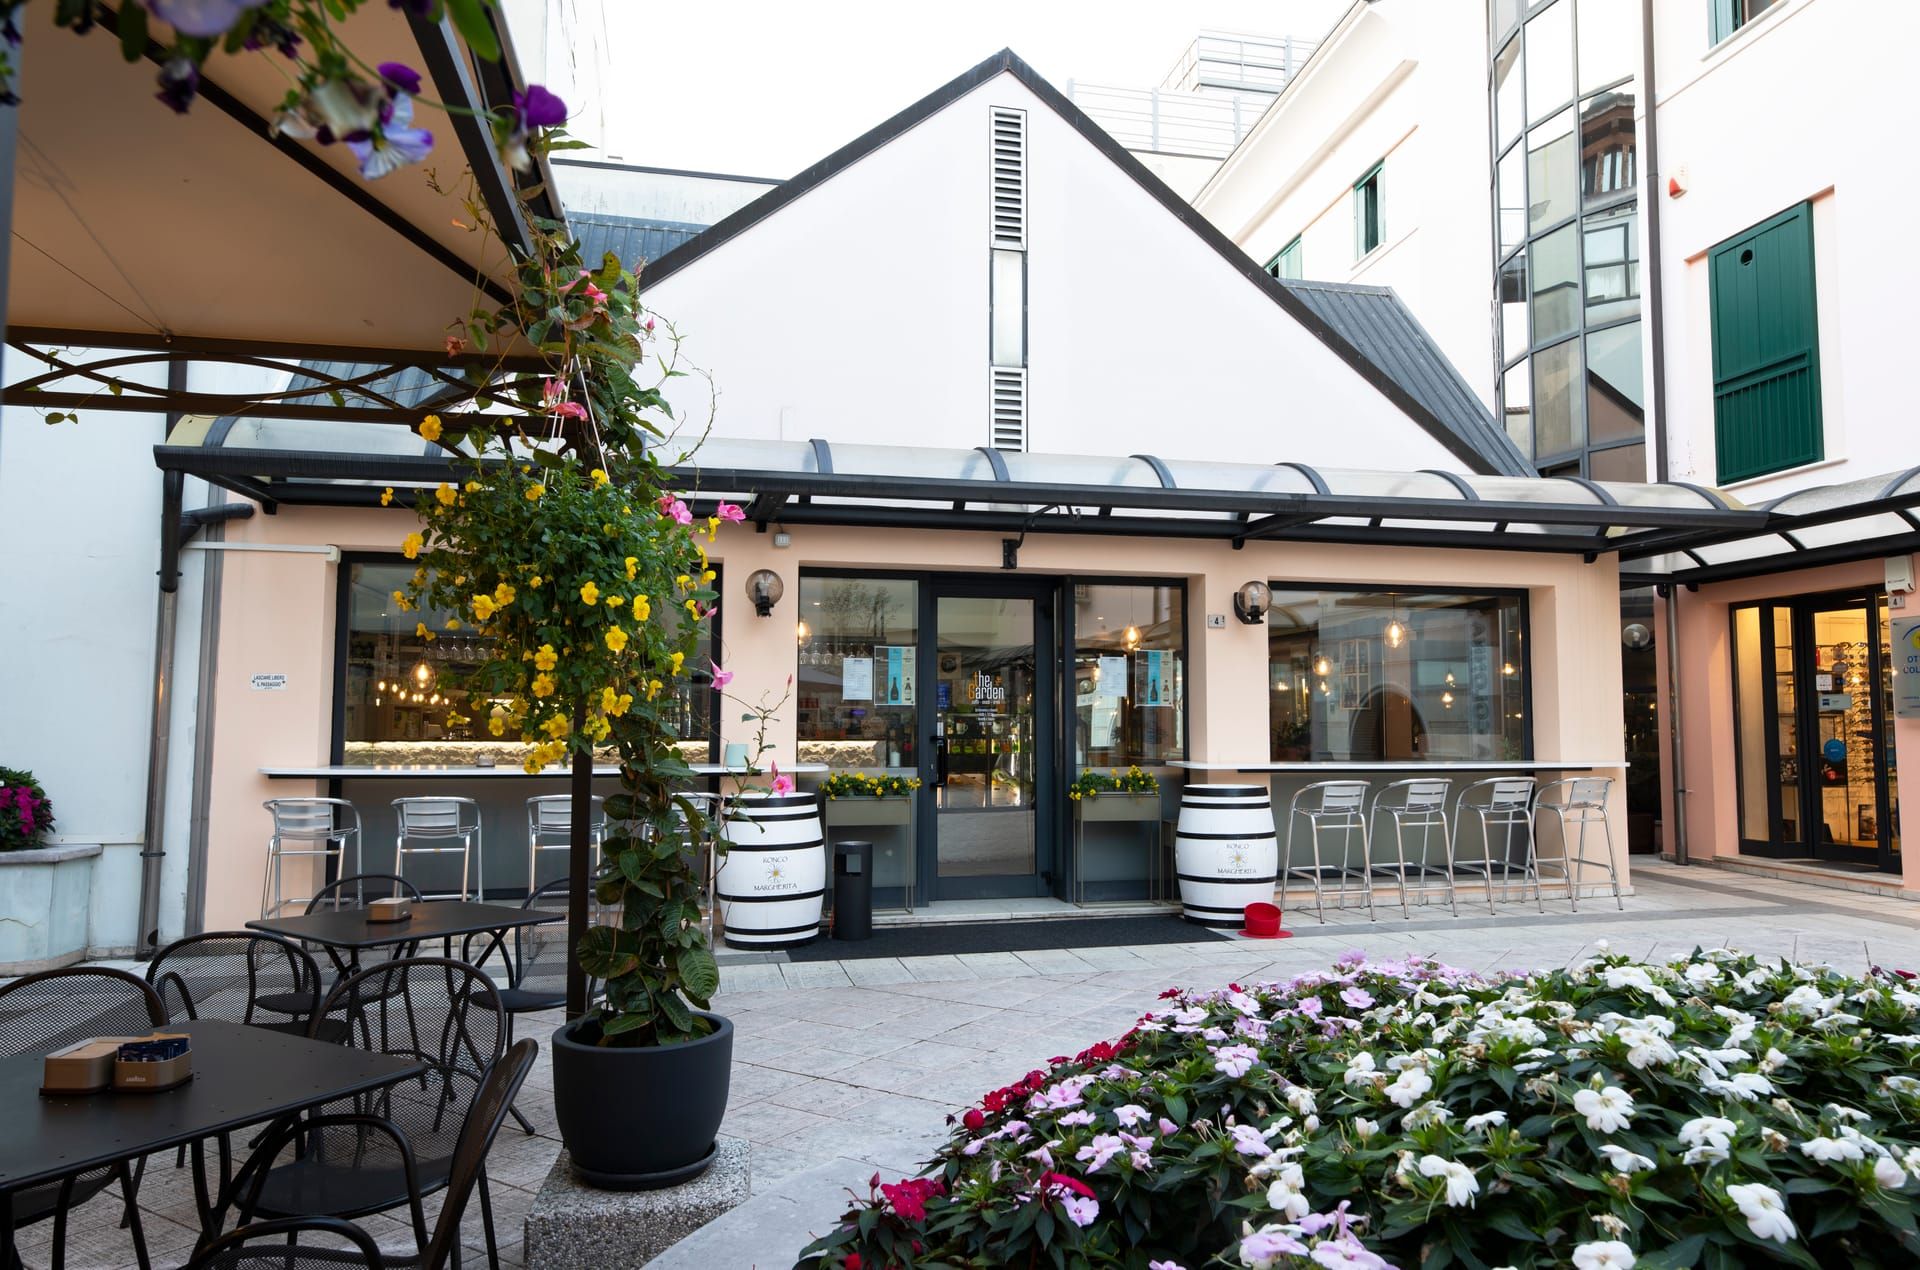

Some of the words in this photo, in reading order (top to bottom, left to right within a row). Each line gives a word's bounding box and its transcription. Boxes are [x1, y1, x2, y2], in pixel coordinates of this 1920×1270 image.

[1907, 655, 1920, 663] OT
[973, 670, 991, 688] the
[968, 681, 1004, 700] Garden
[753, 882, 798, 891] MARGHERITA
